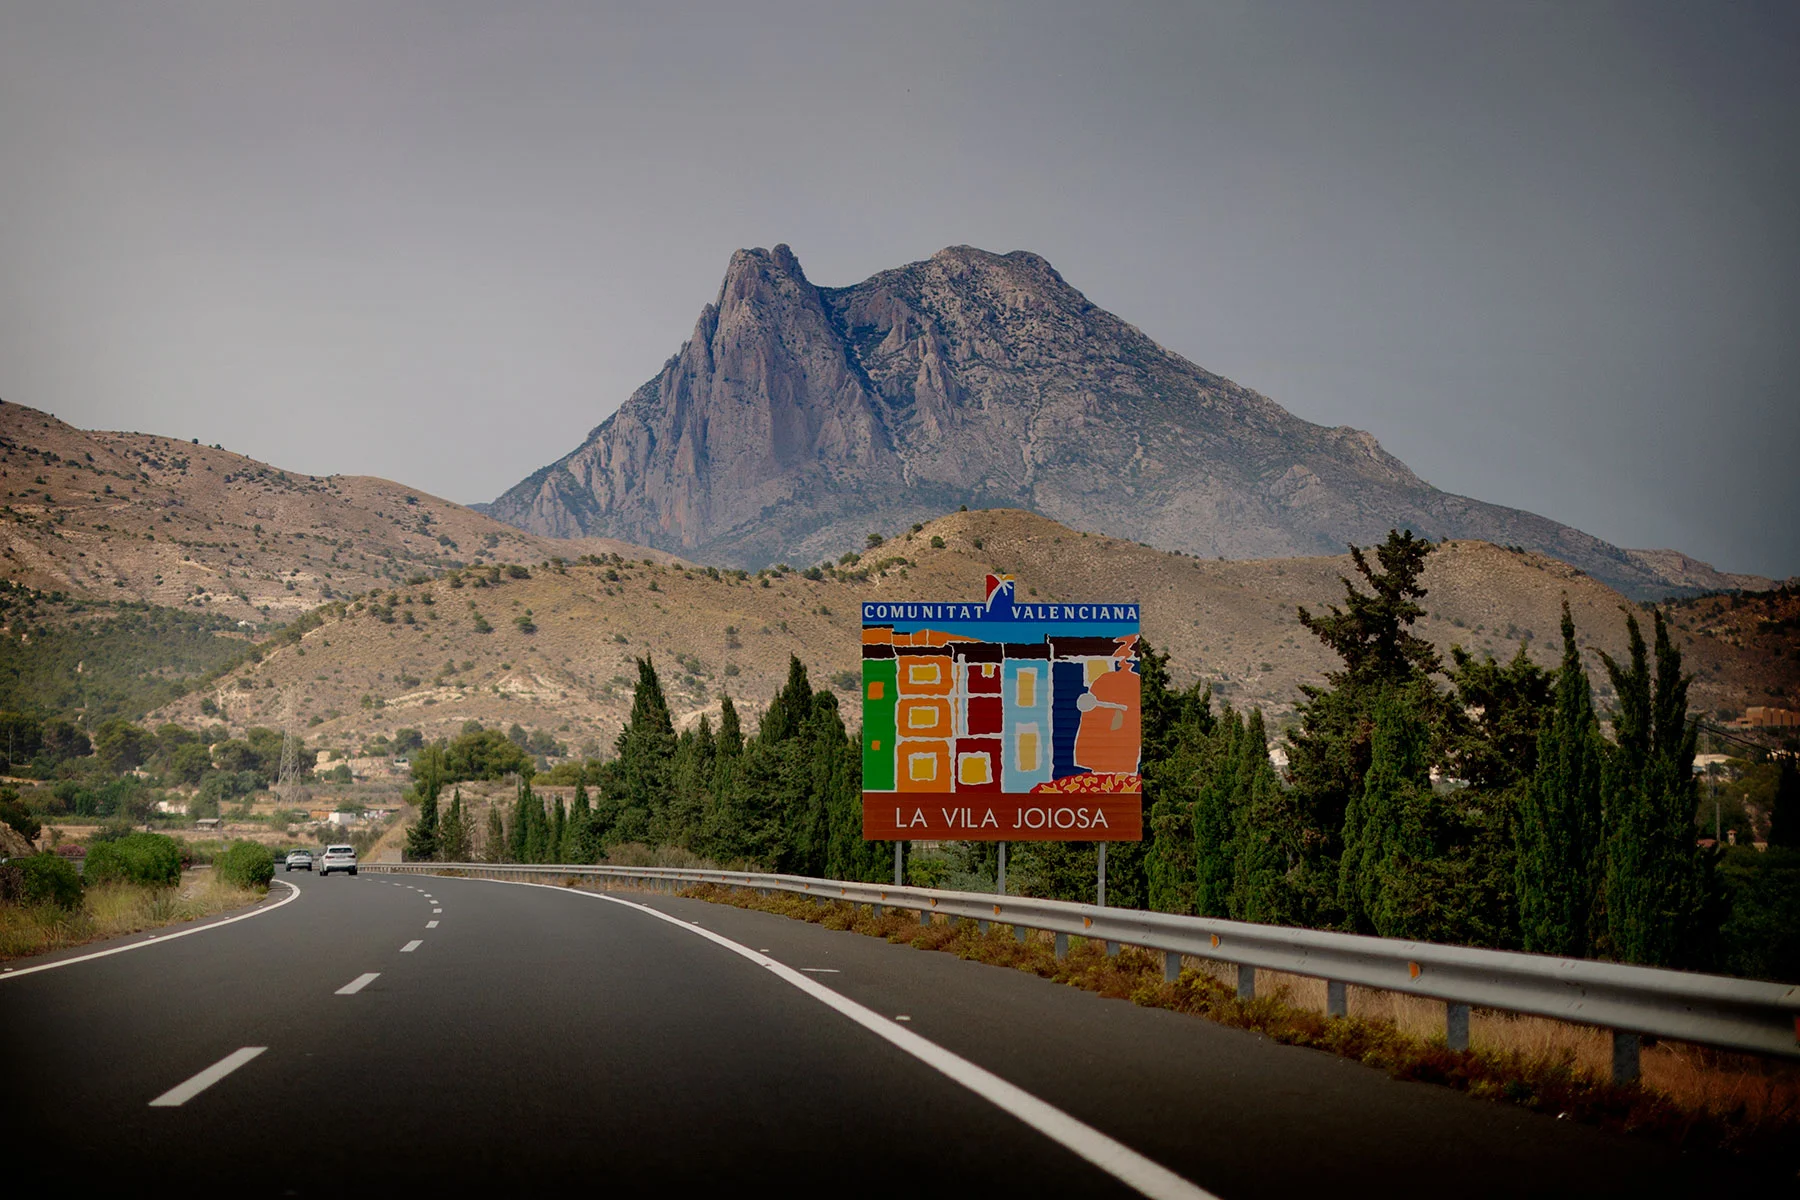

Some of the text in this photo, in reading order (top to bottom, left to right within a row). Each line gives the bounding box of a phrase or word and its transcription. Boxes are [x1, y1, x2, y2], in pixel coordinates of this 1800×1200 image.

[864, 605, 1138, 620] COMUNITAT VALENCIANA
[895, 807, 1109, 829] LA VILA JOIOSA
